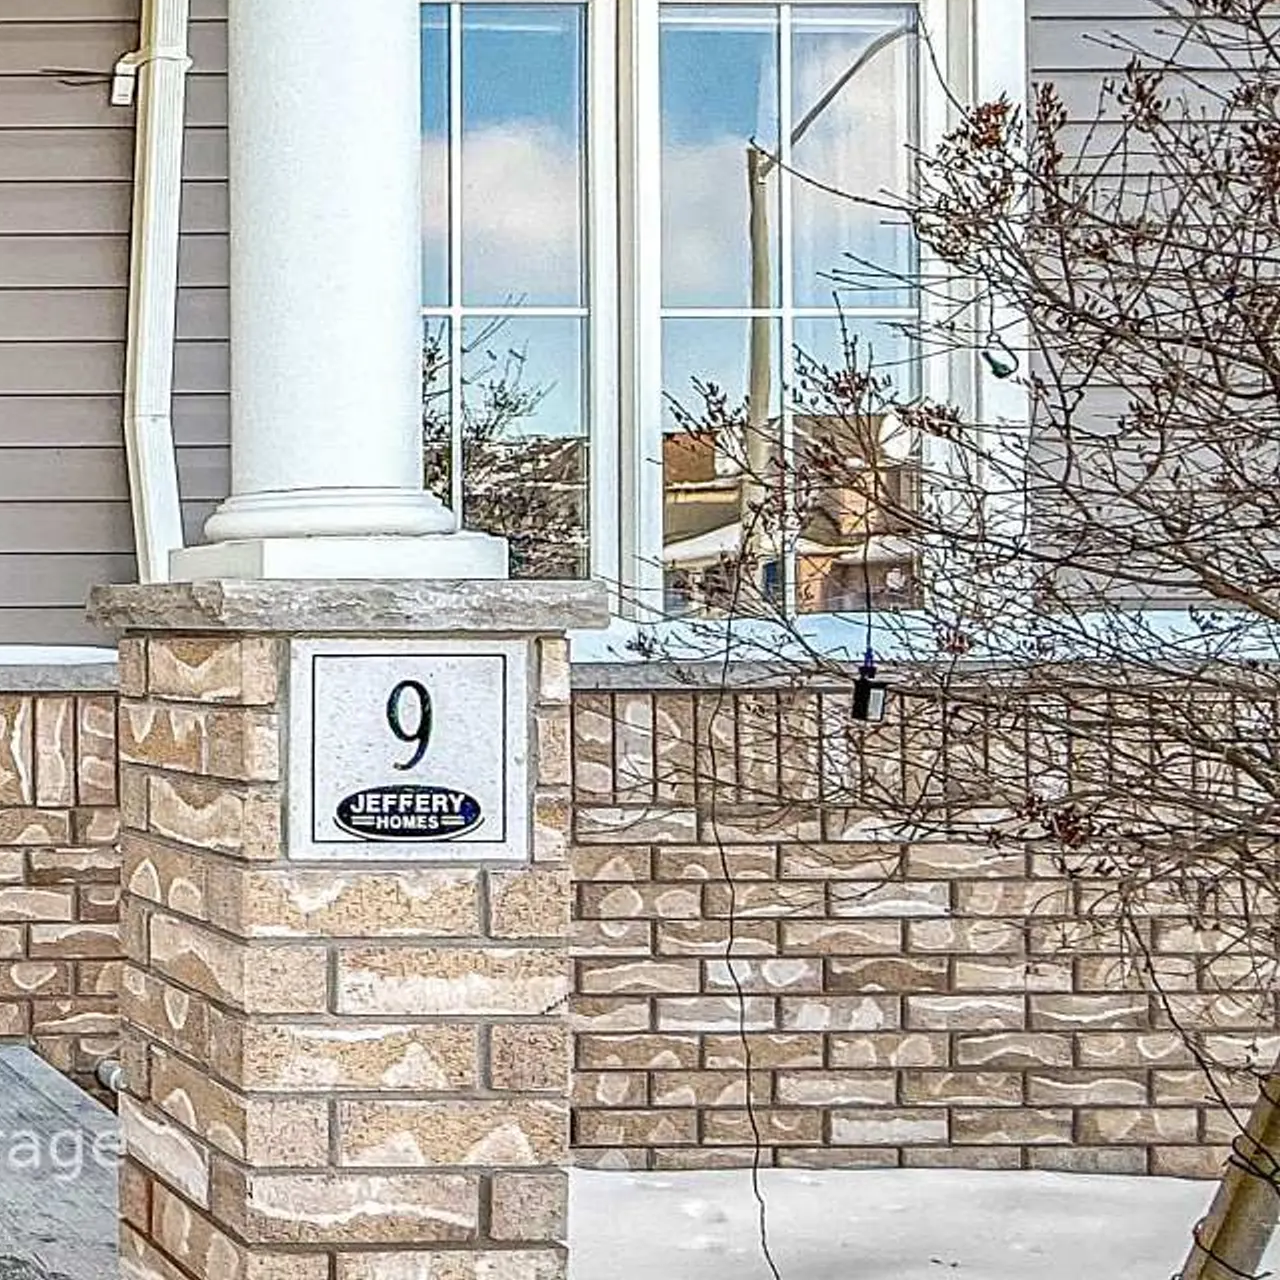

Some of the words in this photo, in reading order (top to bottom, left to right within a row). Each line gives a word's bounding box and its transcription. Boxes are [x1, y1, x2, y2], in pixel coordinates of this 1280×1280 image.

[386, 680, 433, 770] 9
[349, 793, 466, 813] JEFFERY
[376, 816, 439, 829] HOMES
